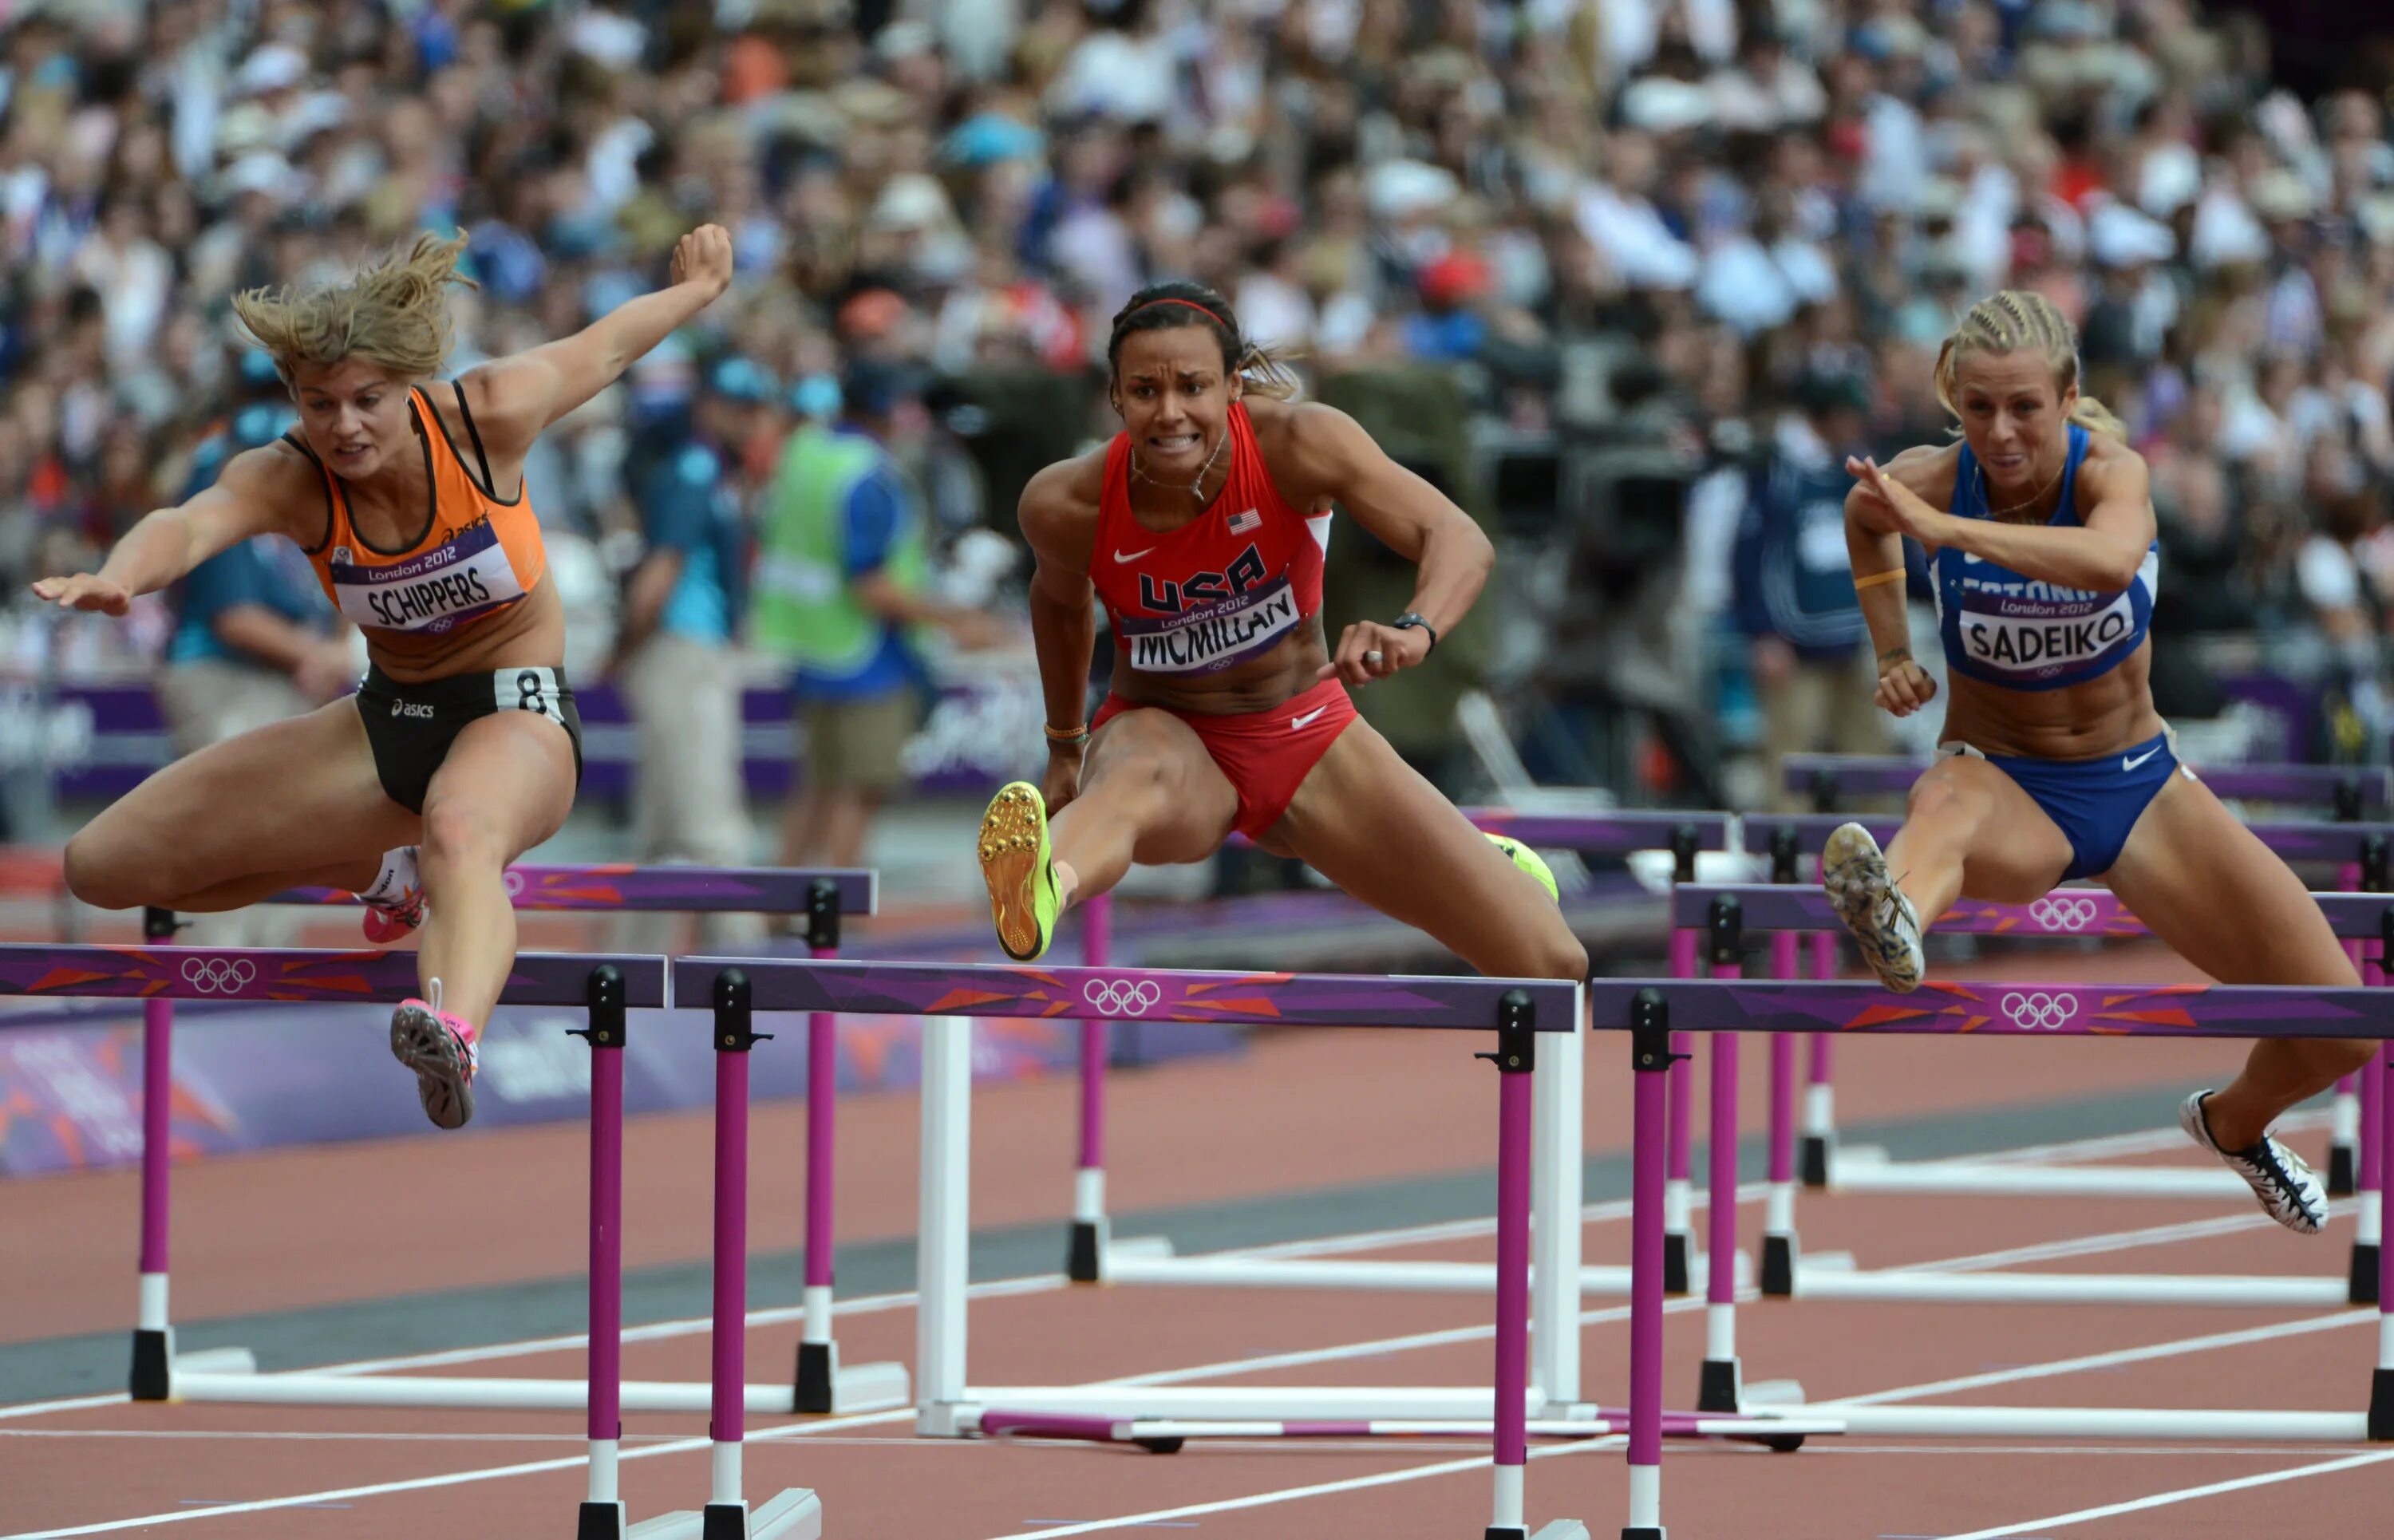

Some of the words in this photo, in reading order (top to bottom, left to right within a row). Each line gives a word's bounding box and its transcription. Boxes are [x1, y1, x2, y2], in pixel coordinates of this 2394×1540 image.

[369, 564, 421, 582] London
[424, 546, 456, 569] 2012
[1139, 542, 1267, 613] USA
[368, 567, 491, 626] SCHIPPERS
[1161, 610, 1214, 629] London
[1217, 595, 1249, 614] 2012
[2001, 599, 2055, 615] London
[2059, 602, 2093, 614] 2012
[1138, 593, 1291, 665] MCMILLAN
[1970, 611, 2125, 664] SADEIKO
[404, 704, 435, 718] asics
[517, 669, 547, 714] 8
